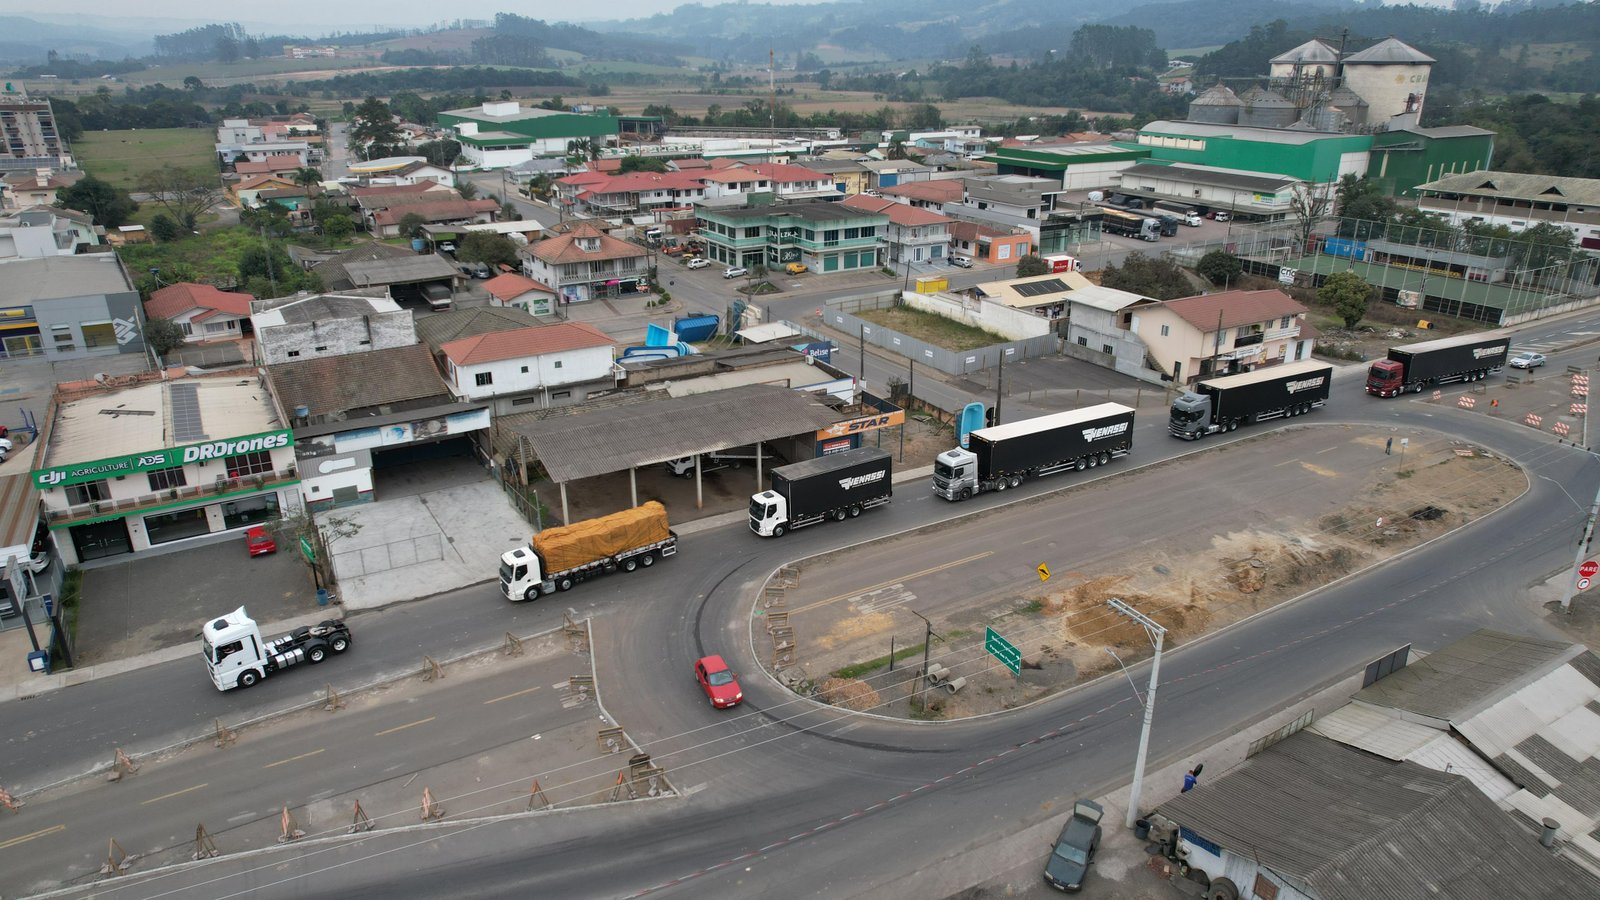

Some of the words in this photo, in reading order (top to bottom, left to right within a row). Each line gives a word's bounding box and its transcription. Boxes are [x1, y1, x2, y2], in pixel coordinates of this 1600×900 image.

[848, 416, 890, 432] STAR
[71, 461, 129, 477] AGRICULTURE
[183, 433, 288, 463] DRDrones
